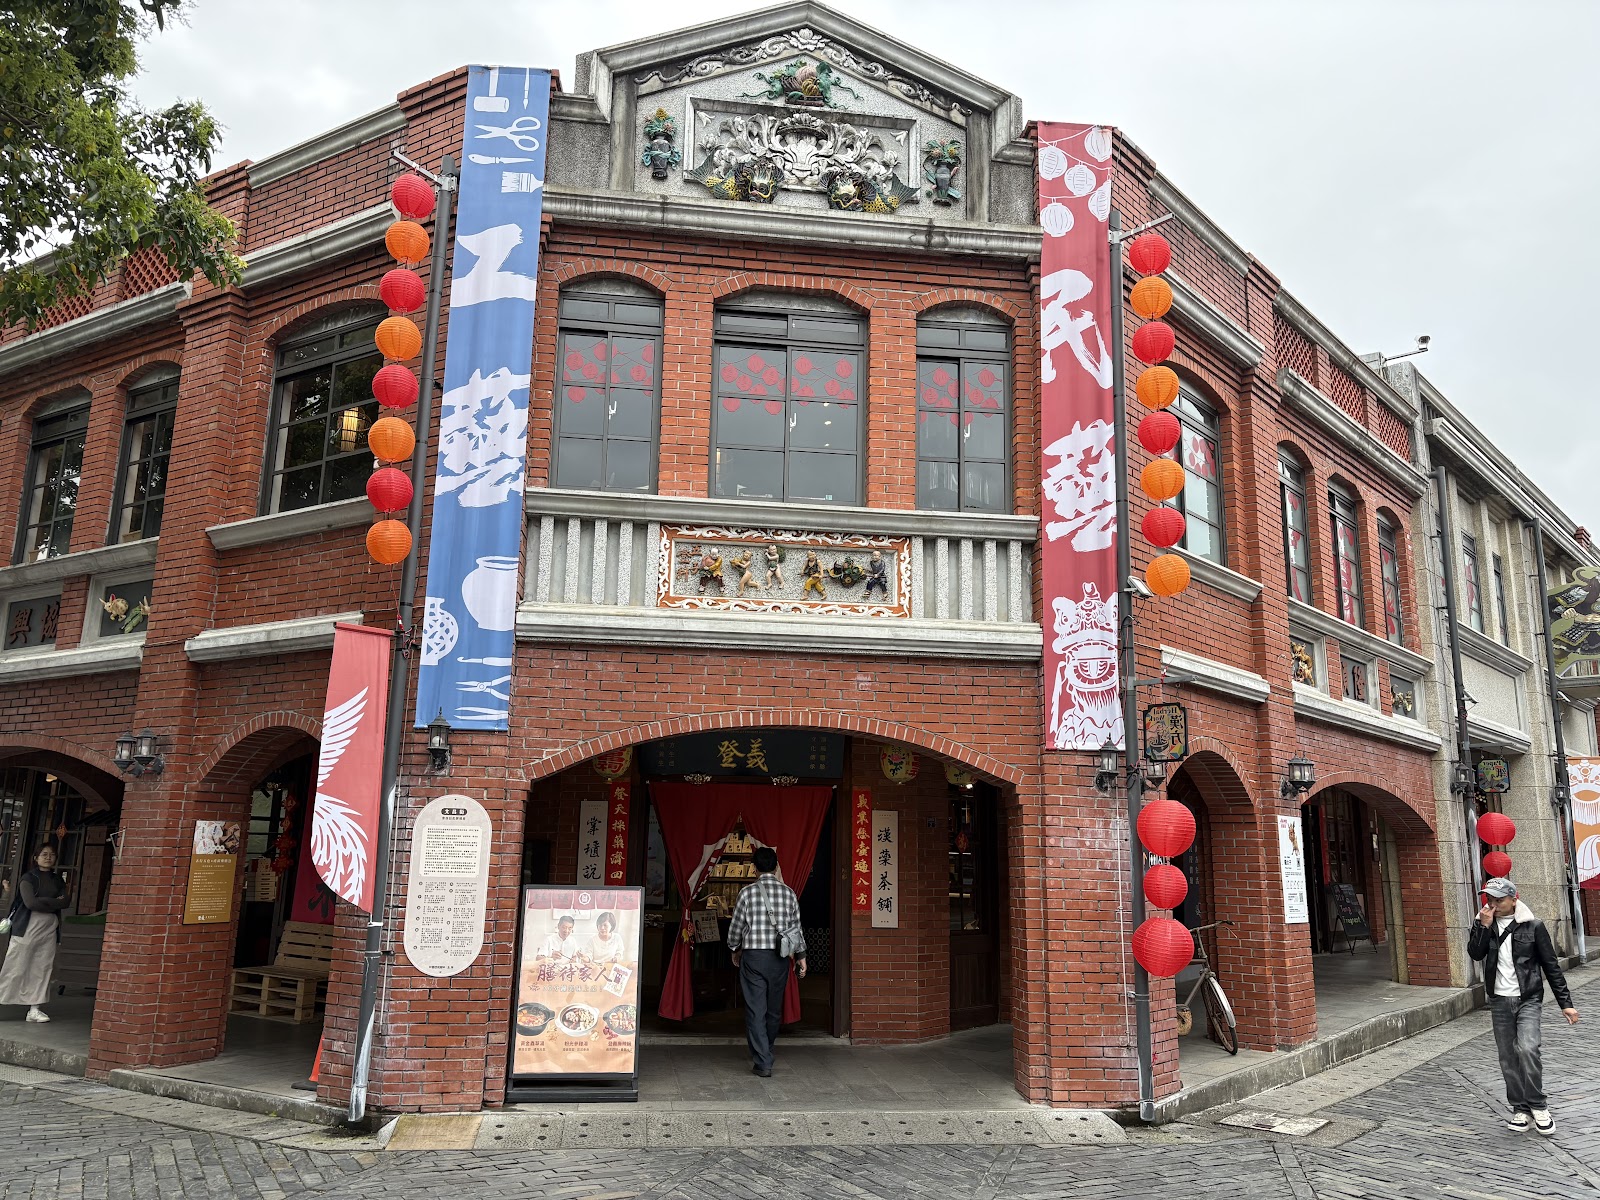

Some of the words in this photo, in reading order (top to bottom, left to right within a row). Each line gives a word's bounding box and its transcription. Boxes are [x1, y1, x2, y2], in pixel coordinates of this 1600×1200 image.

[434, 223, 536, 507] 工藝
[1040, 268, 1117, 553] 民藝
[716, 738, 769, 773] 登義
[582, 816, 602, 880] 掌櫃說
[876, 827, 893, 914] 漢藥茶鋪
[537, 963, 613, 982] 膳待家人
